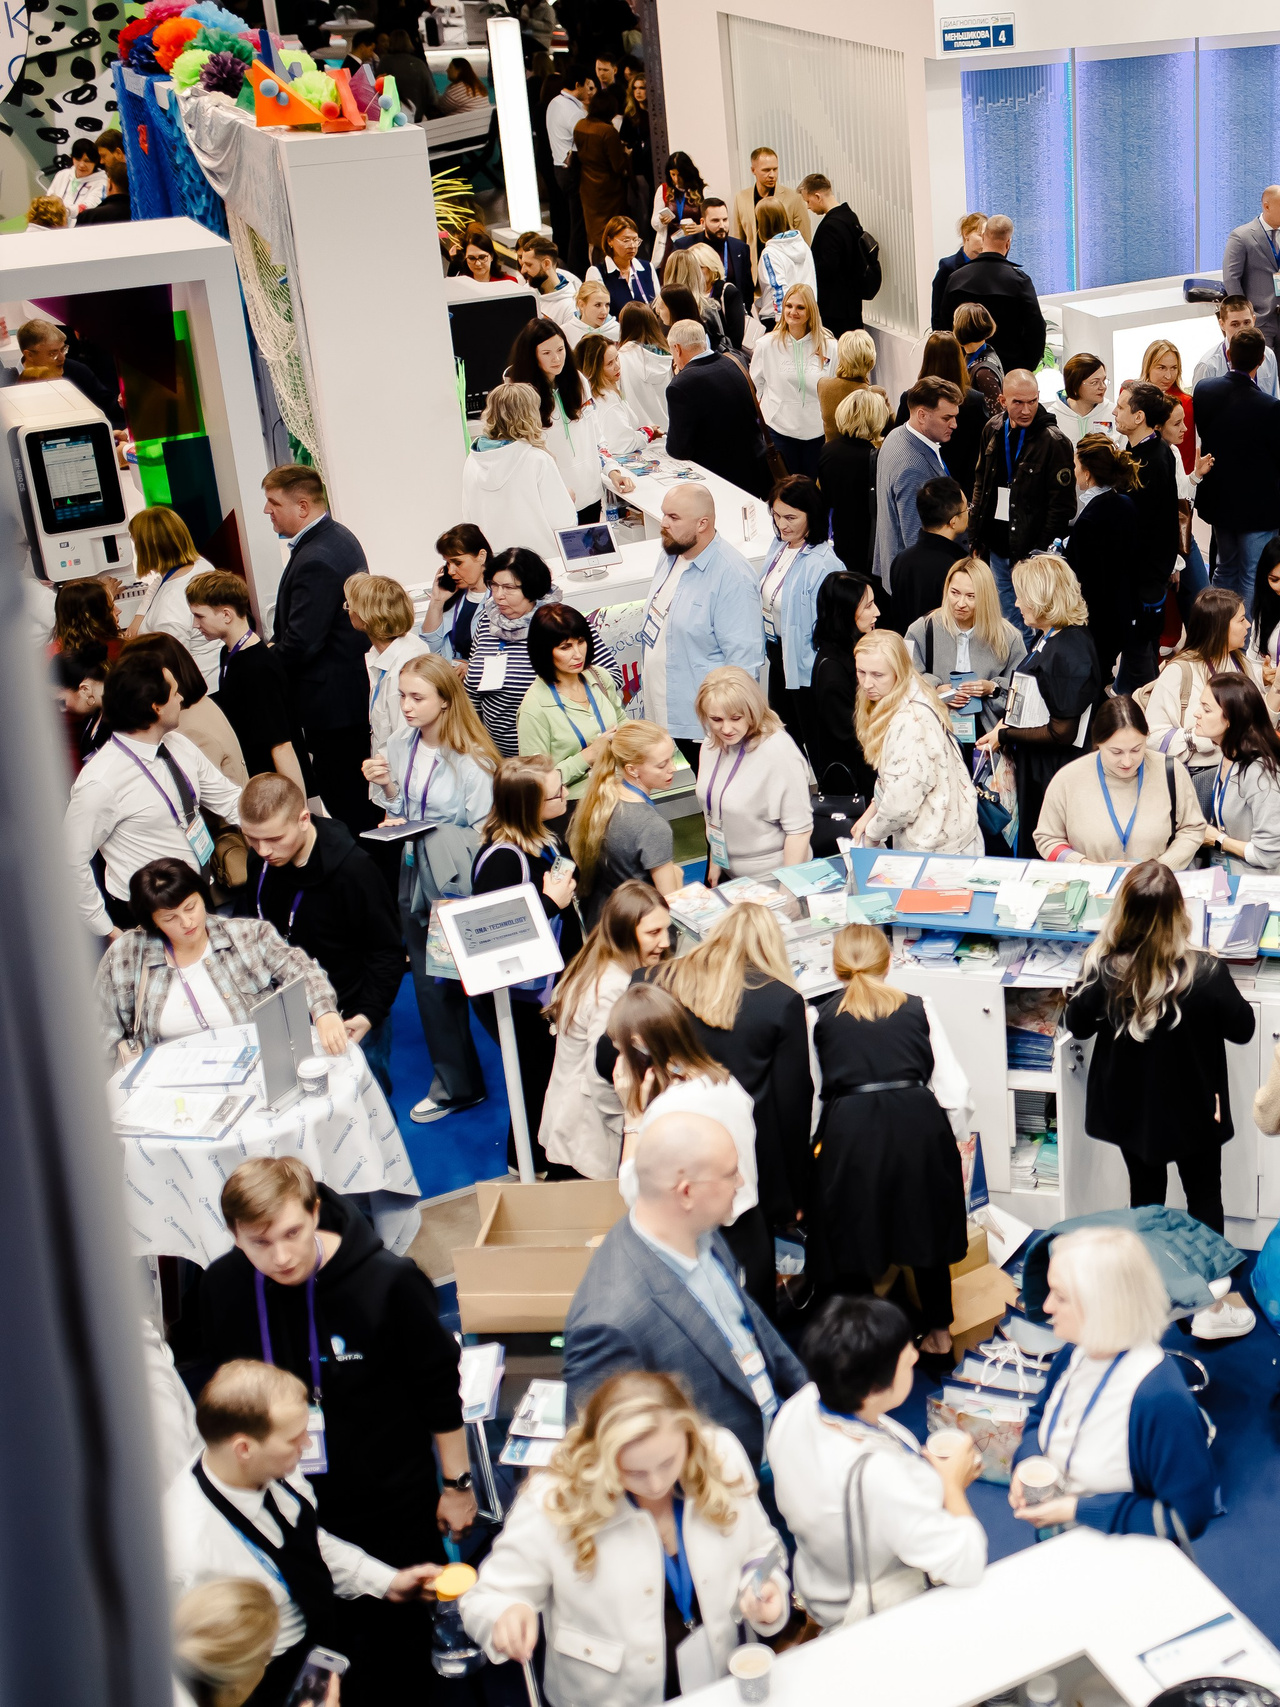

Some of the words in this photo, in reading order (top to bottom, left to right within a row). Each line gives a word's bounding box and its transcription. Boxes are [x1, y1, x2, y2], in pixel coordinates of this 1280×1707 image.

[943, 17, 989, 28] ДИАГНОПОЛИС
[944, 30, 989, 41] МЕНЬШИКОВА
[998, 30, 1006, 43] 4
[954, 40, 981, 48] ПЛОЩАДЬ
